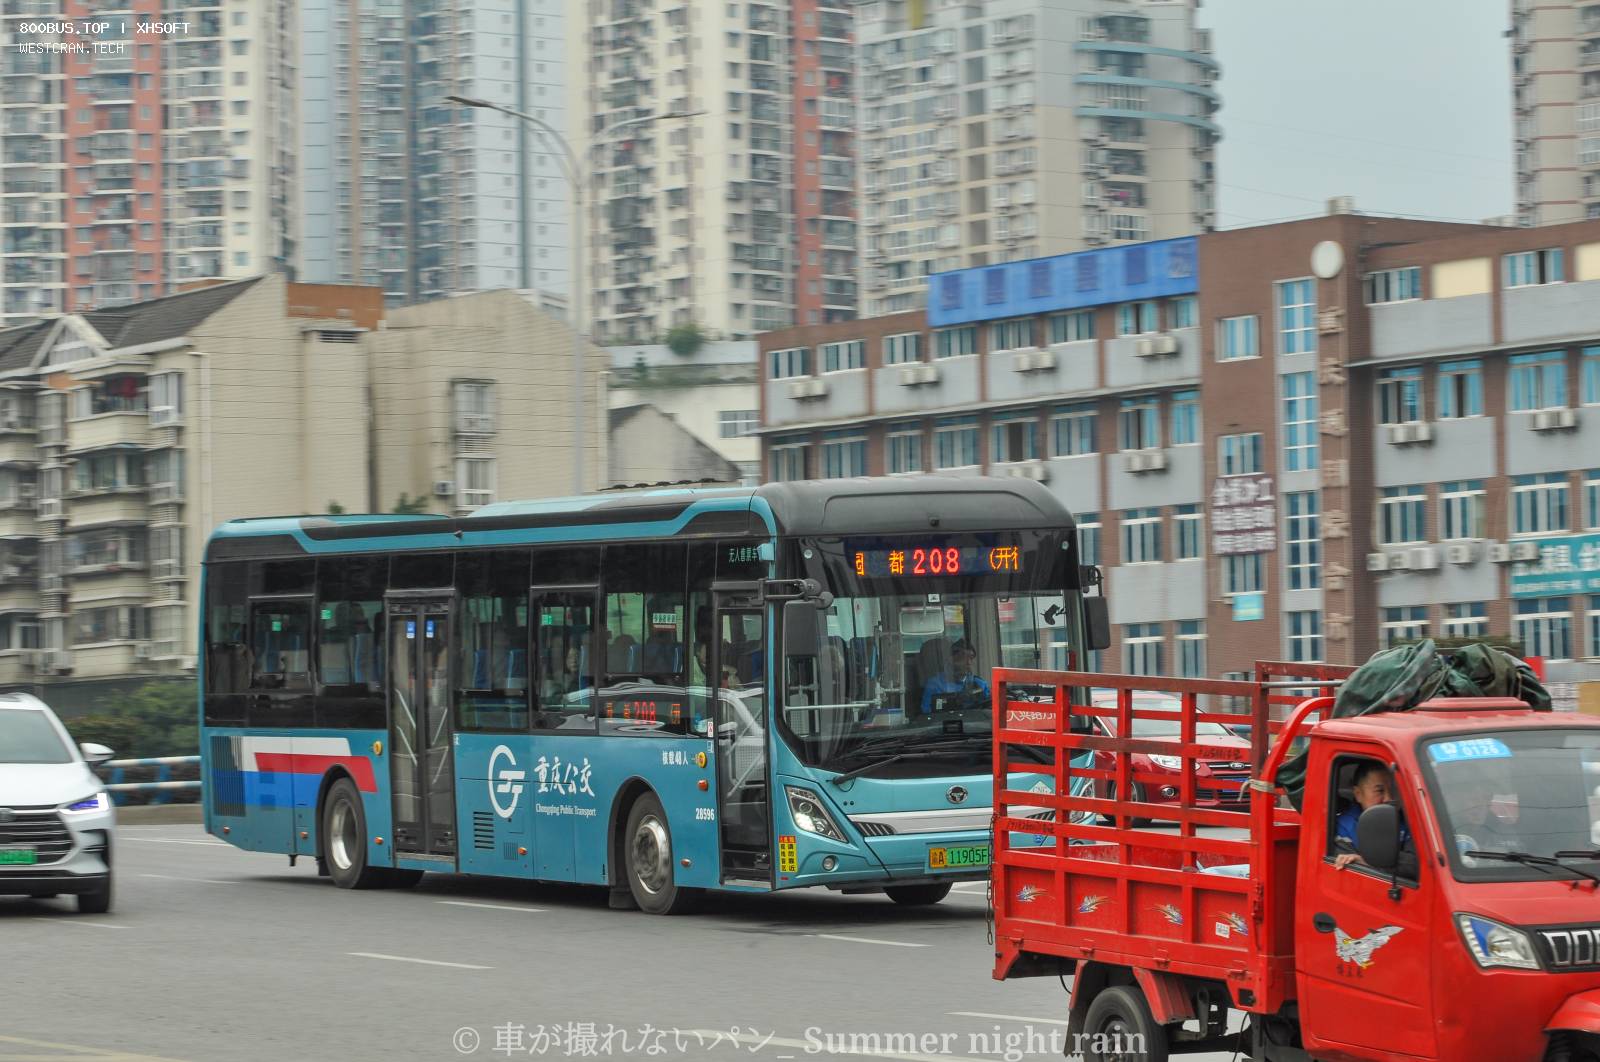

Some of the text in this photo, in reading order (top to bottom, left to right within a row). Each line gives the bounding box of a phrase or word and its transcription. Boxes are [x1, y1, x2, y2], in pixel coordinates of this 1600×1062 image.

[913, 548, 960, 574] 208
[634, 701, 656, 725] 208
[534, 756, 595, 797] 重庆公交
[536, 804, 596, 819] Chongqing Public Transport
[695, 808, 715, 821] 28596
